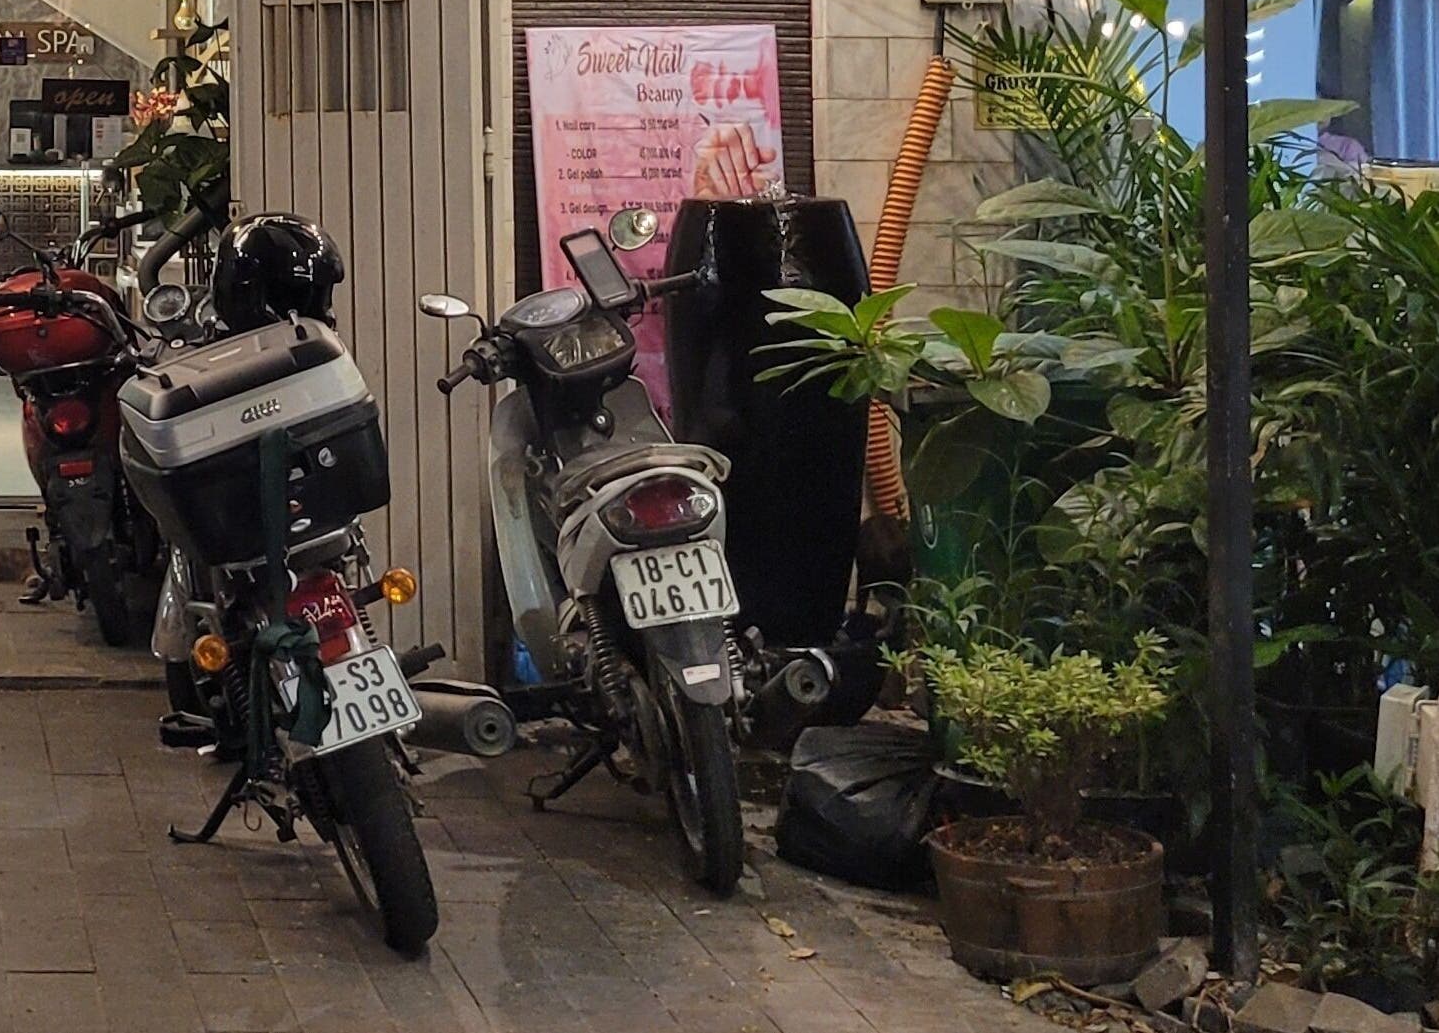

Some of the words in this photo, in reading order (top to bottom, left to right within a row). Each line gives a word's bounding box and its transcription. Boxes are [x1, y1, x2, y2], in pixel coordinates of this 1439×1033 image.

[37, 29, 82, 54] SPA
[576, 40, 638, 77] Sweet
[637, 42, 684, 77] Nail
[636, 83, 683, 107] Beauty
[631, 547, 709, 585] 18-C1
[630, 577, 725, 620] 046.17
